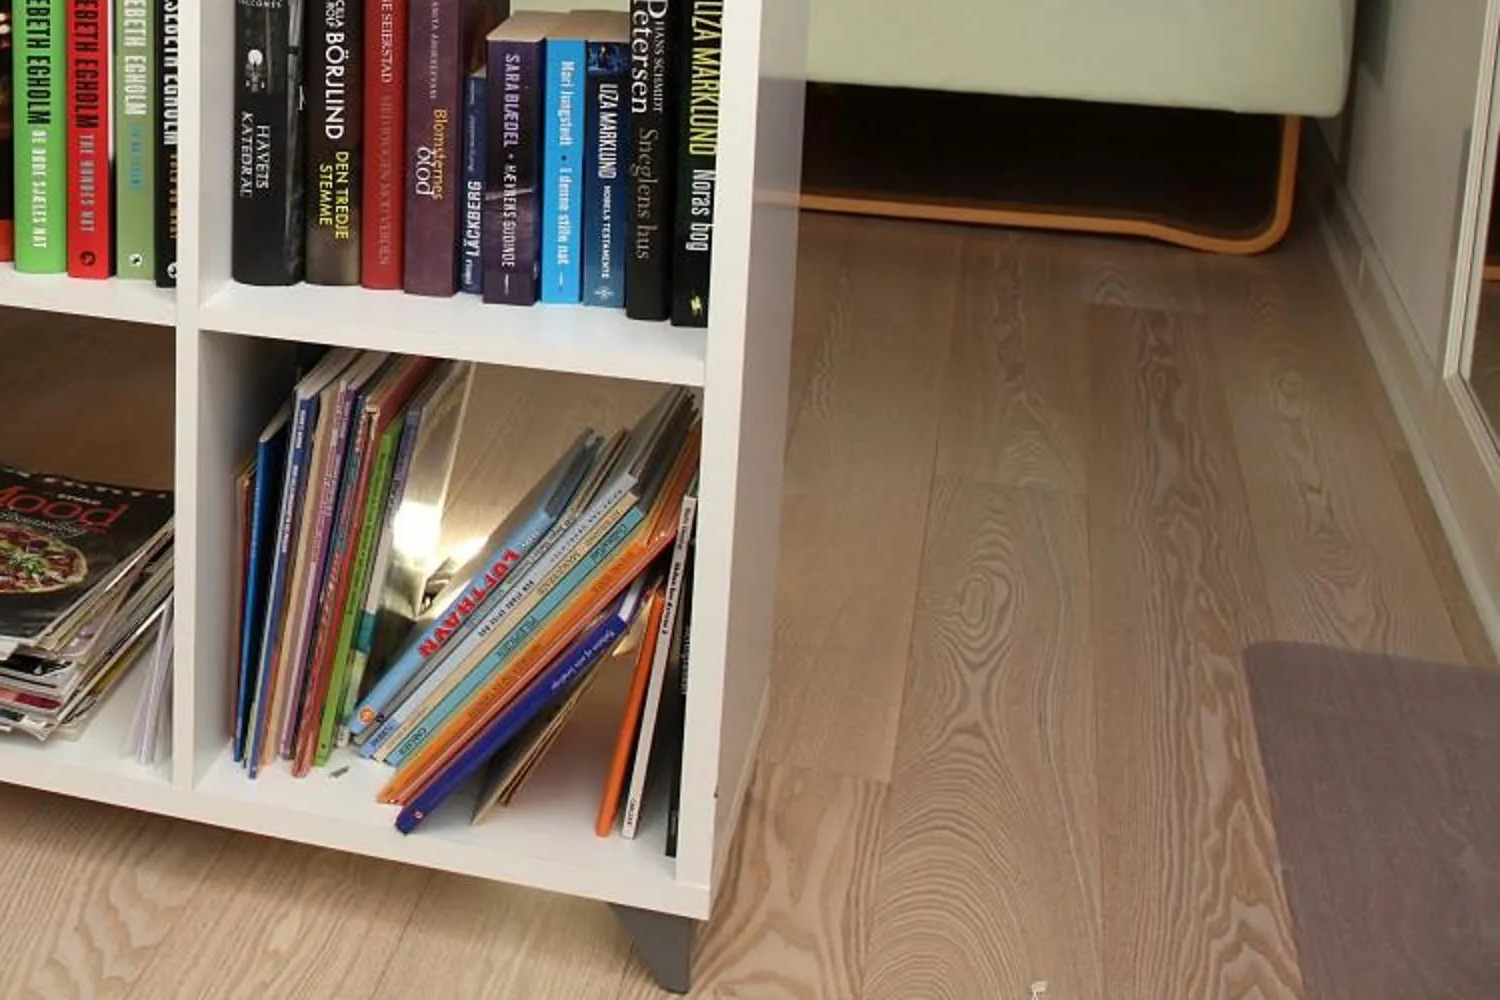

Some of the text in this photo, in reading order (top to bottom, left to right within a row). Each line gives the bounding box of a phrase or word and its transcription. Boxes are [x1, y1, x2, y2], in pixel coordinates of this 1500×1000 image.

[335, 0, 345, 28] CILLA
[381, 14, 393, 83] SEIERSTAD
[27, 55, 51, 125] EGHOLM
[75, 59, 100, 129] EGHOLM
[125, 55, 148, 115] EGHOLM
[324, 33, 350, 140] BÖRJLIND
[504, 54, 520, 148] SARA BLÆDEL
[557, 61, 574, 146] Mari Jungstedt
[653, 20, 665, 113] HANS SCHMIDT
[689, 0, 722, 156] LIZA MARKLUND
[240, 111, 253, 198] KATEDRAL
[255, 125, 270, 189] HAVETS
[429, 109, 449, 200] Blomsternes
[598, 84, 618, 179] LIZA MARKLUND
[319, 164, 333, 225] STEMME
[335, 152, 349, 239] DEN TREDJE
[462, 181, 482, 257] LÄCKBERG
[630, 127, 659, 260] Sneglens hus
[686, 168, 715, 252] Noras bog
[557, 247, 571, 265] nat
[418, 548, 522, 659] LUFTHAVN
